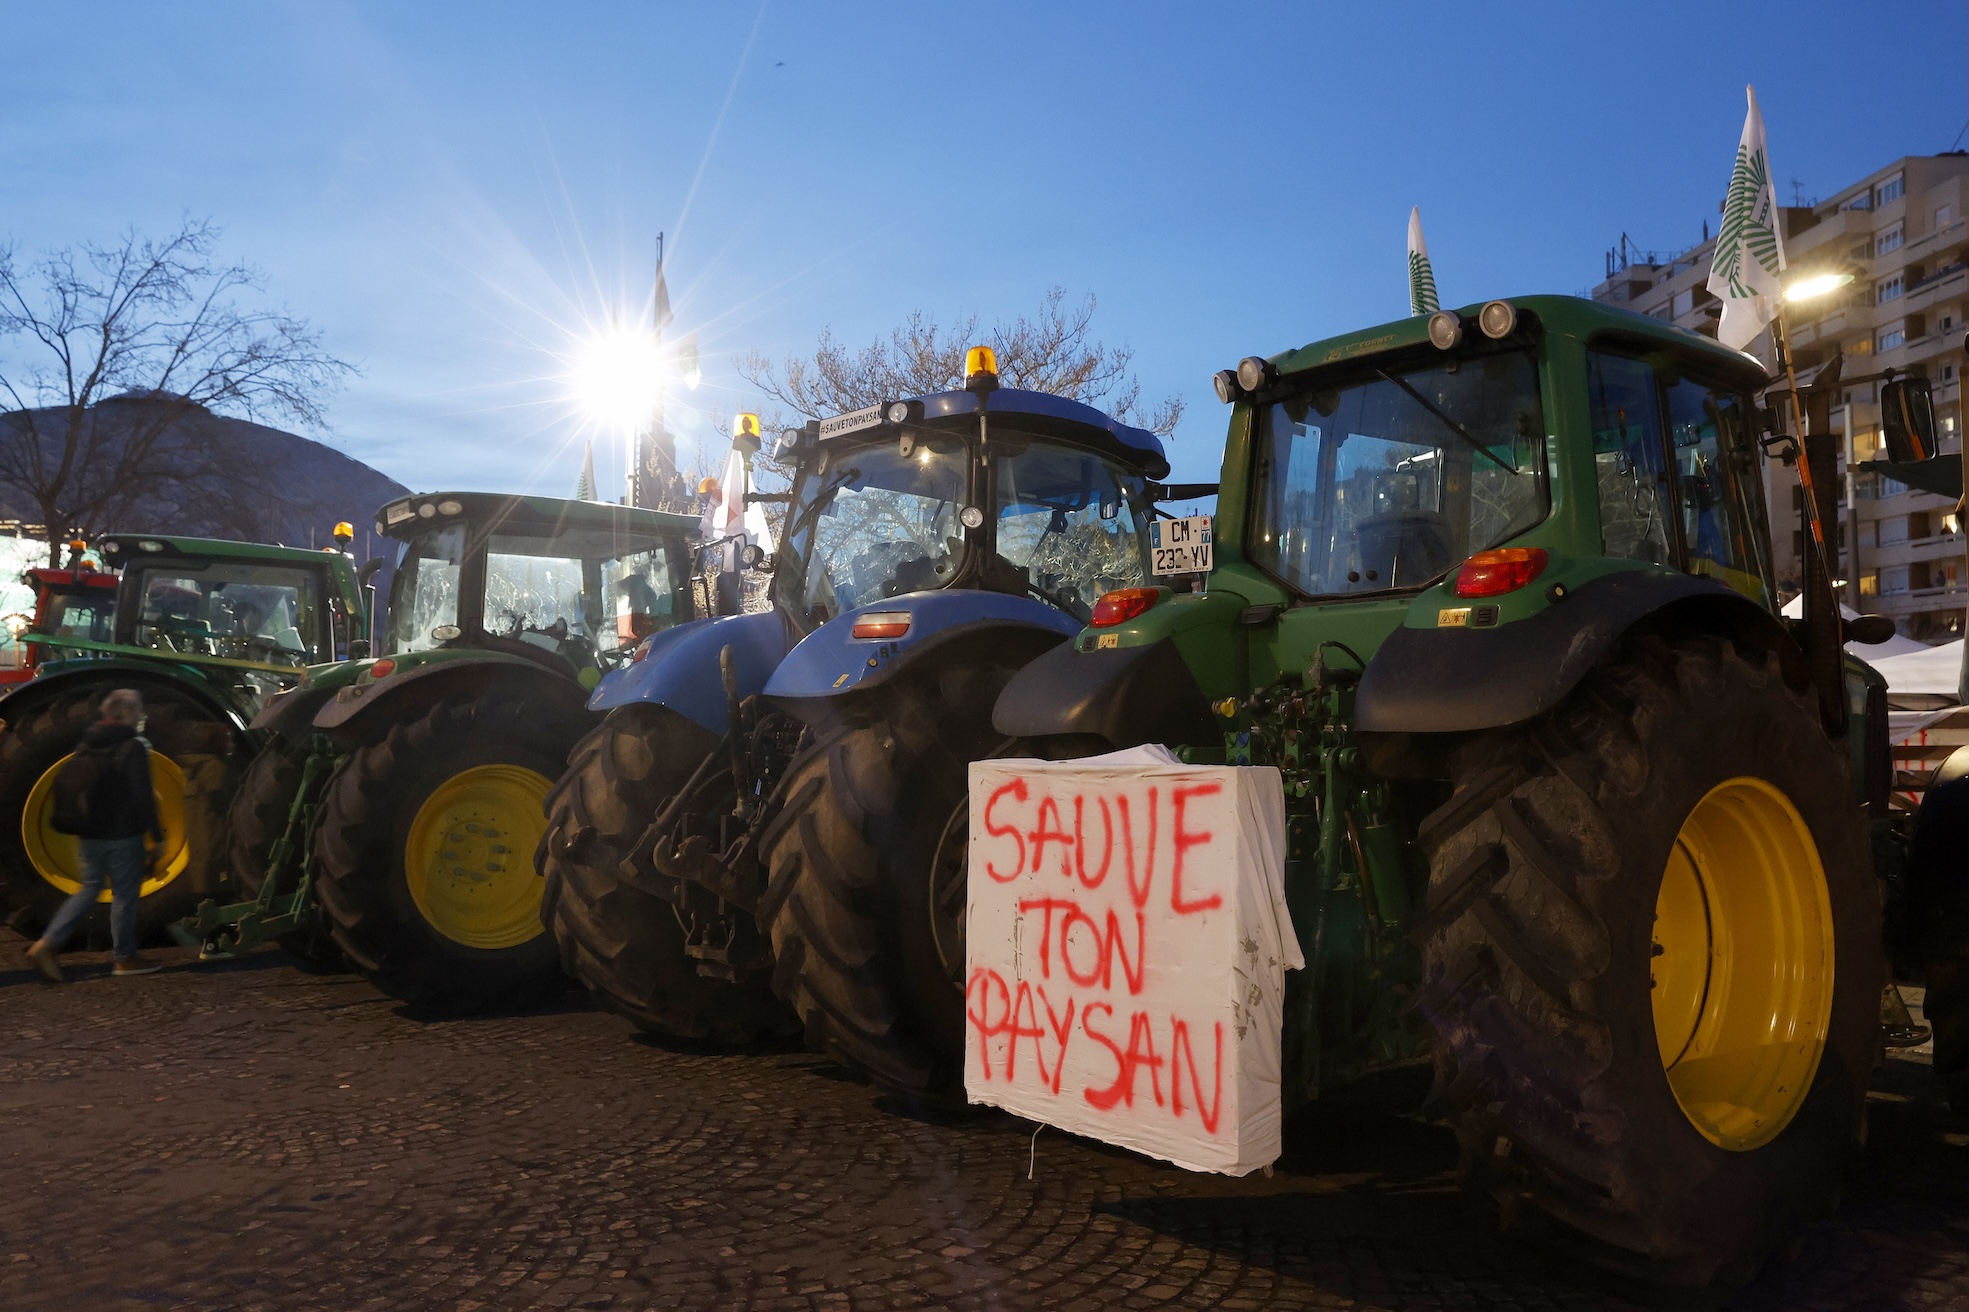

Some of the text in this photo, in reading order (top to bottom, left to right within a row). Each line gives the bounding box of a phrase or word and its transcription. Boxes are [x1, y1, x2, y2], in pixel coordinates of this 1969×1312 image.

[984, 777, 1223, 914] SAUVE
[1019, 896, 1146, 997] TON
[966, 967, 1223, 1135] PAYSAN
